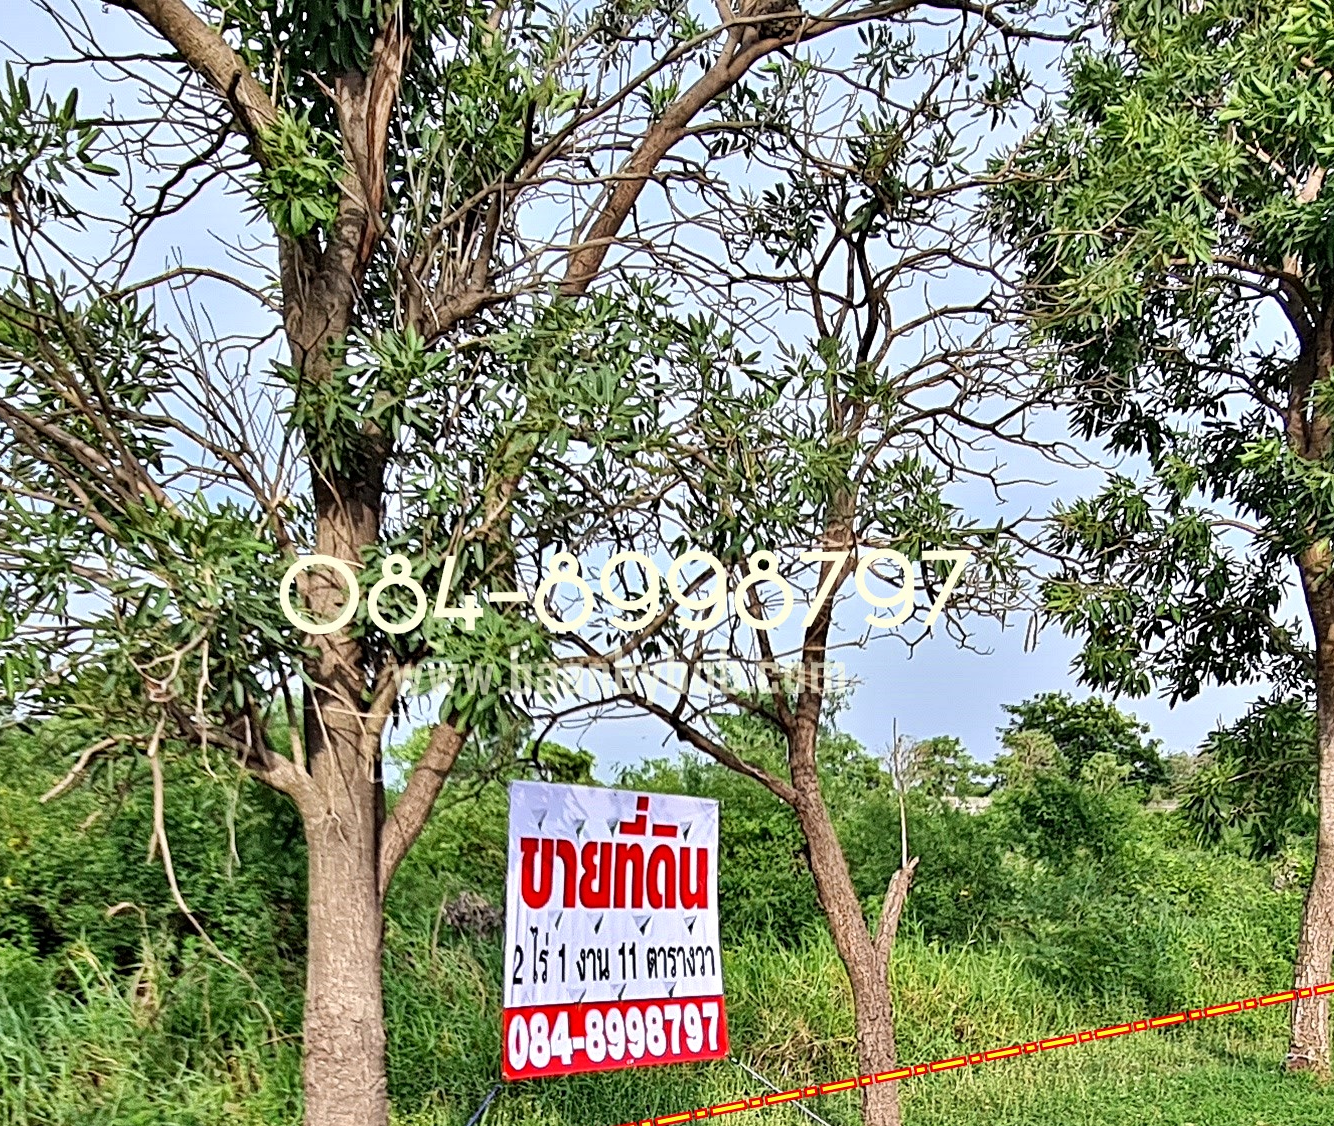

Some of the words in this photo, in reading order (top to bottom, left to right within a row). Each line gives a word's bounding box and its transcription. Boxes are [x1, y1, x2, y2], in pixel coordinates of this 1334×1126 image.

[520, 796, 708, 909] ขายที่ดิน
[513, 944, 524, 985] 2
[530, 926, 549, 984] ไร่
[558, 943, 566, 983] 1
[576, 947, 610, 981] งาน
[618, 941, 637, 981] 11
[647, 945, 715, 979] ตารางวา
[508, 1001, 719, 1071] 084-8998797
